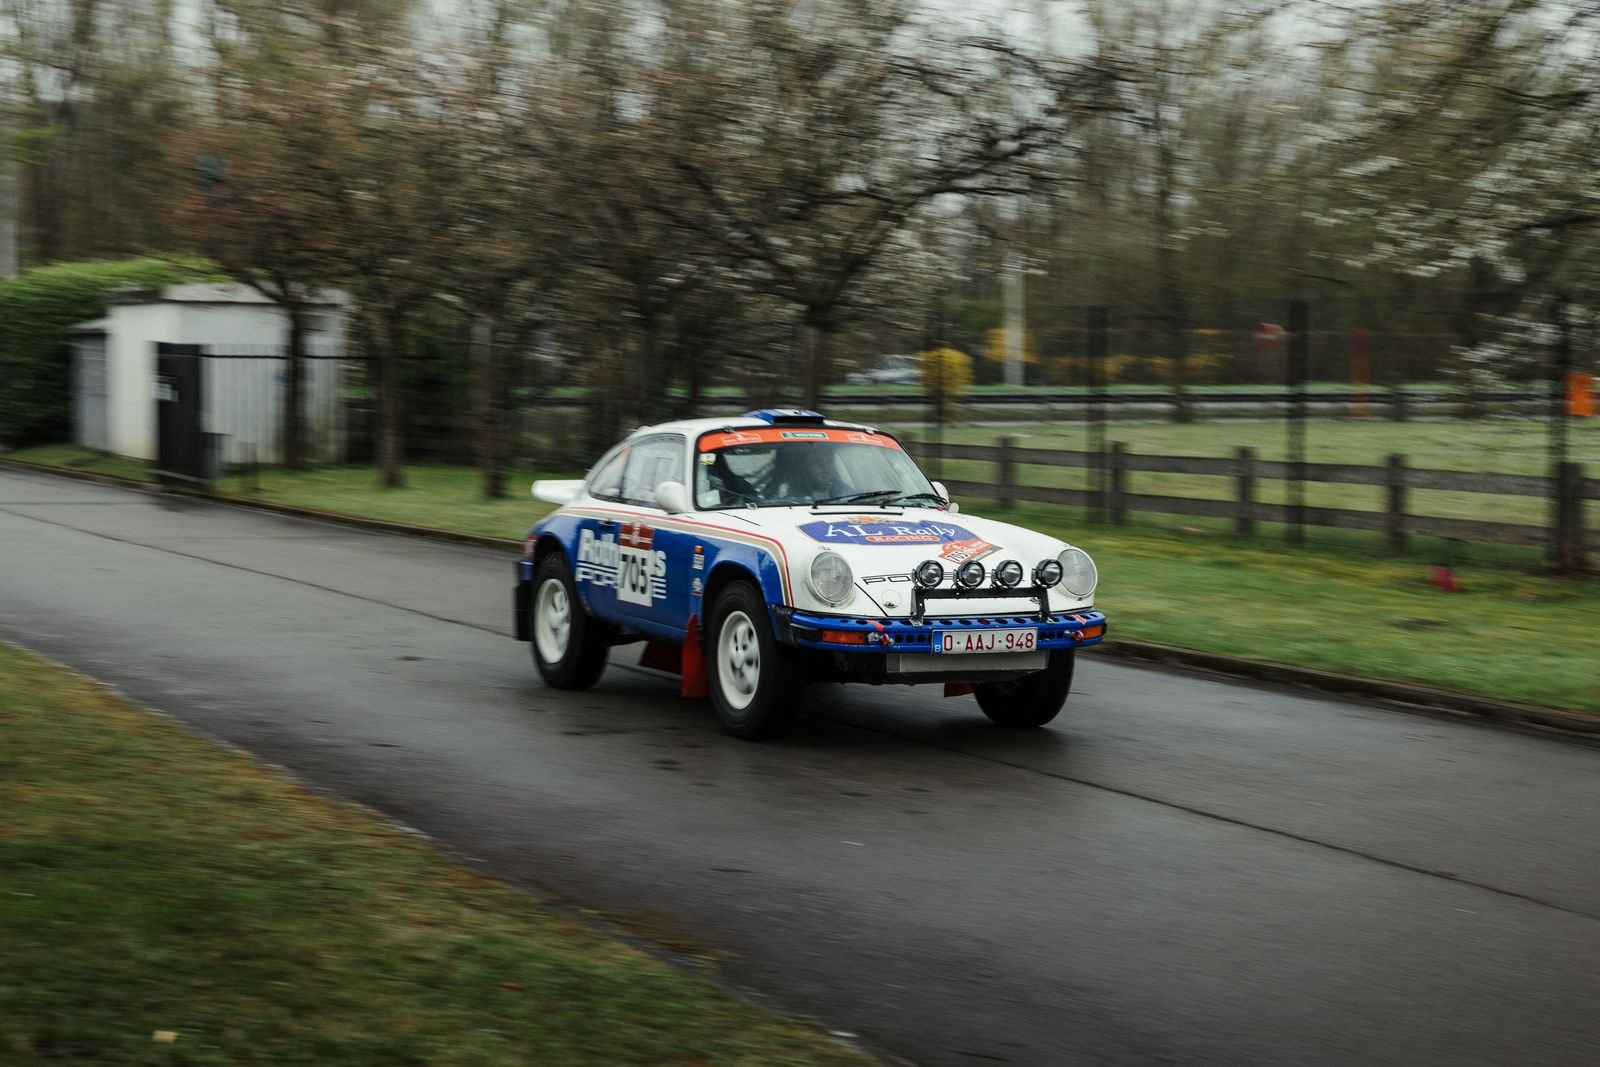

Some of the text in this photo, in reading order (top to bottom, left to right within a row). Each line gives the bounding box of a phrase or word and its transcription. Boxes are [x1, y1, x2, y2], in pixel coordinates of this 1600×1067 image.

[824, 524, 956, 537] AL Rally
[577, 528, 667, 577] Roths
[620, 553, 649, 595] 705
[934, 644, 942, 652] B
